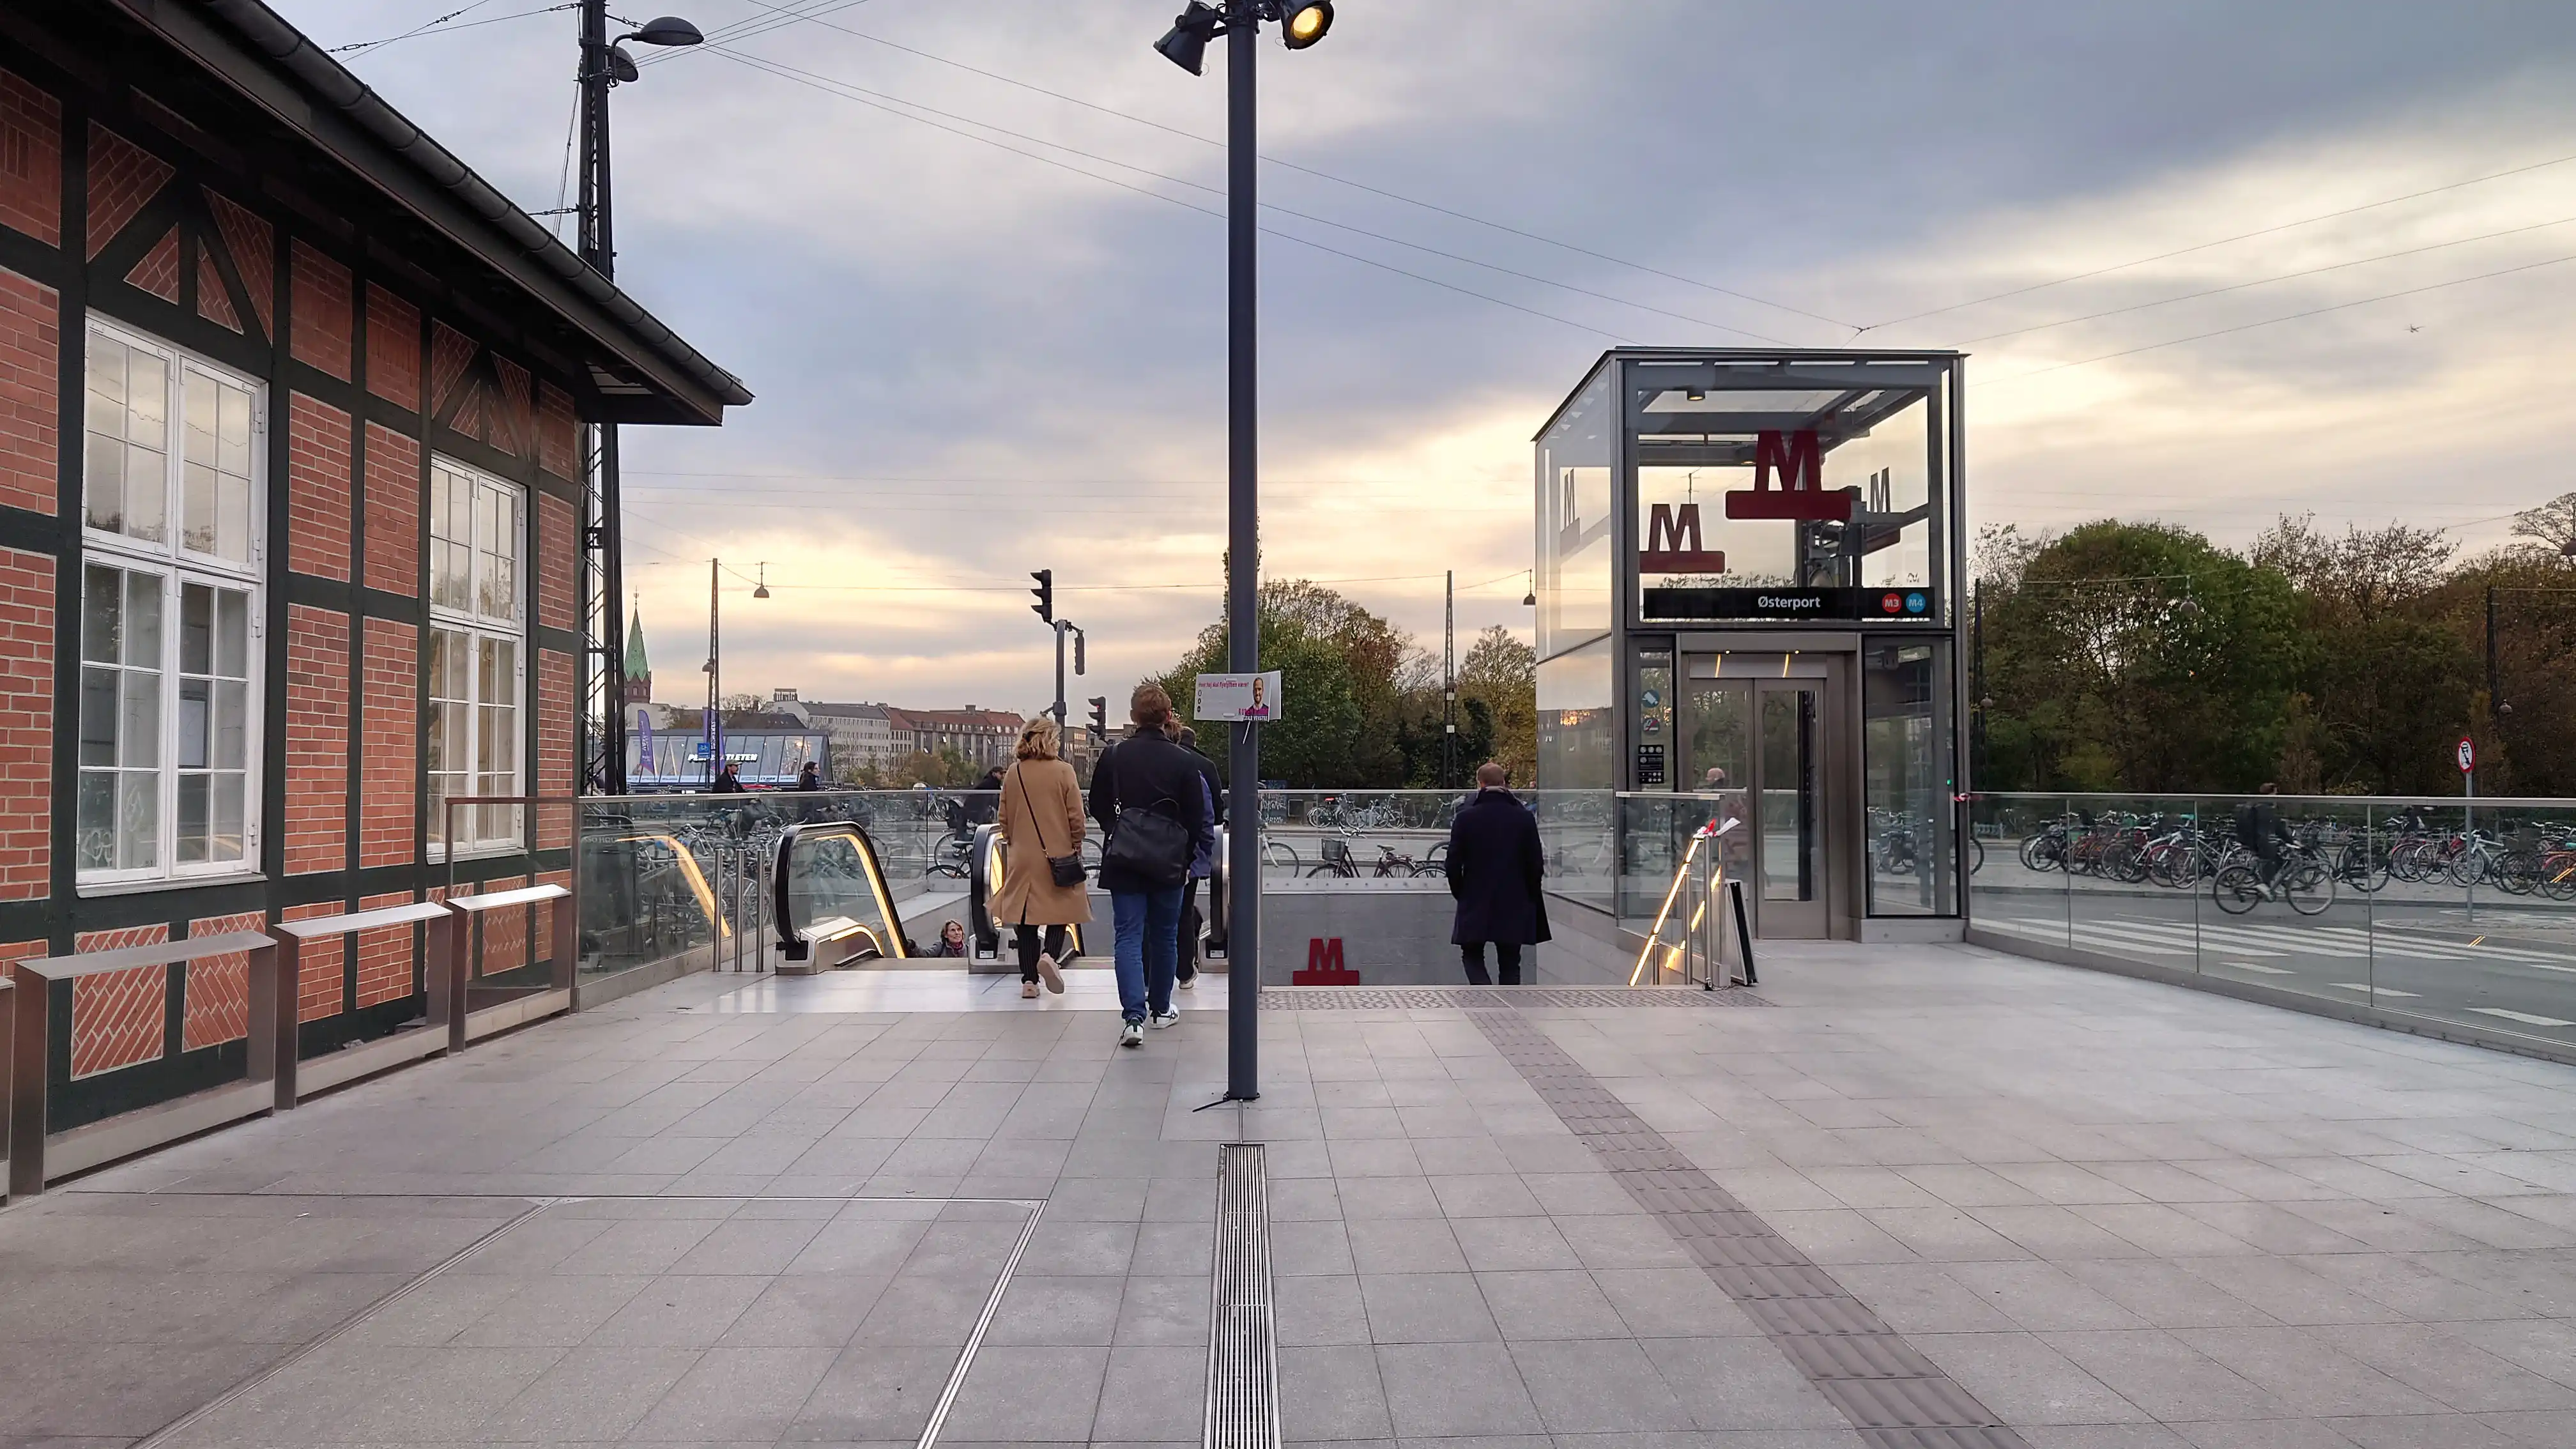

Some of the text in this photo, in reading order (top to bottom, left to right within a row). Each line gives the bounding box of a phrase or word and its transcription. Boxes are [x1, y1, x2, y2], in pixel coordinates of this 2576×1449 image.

[1758, 595, 1924, 611] Østerport M3 M4
